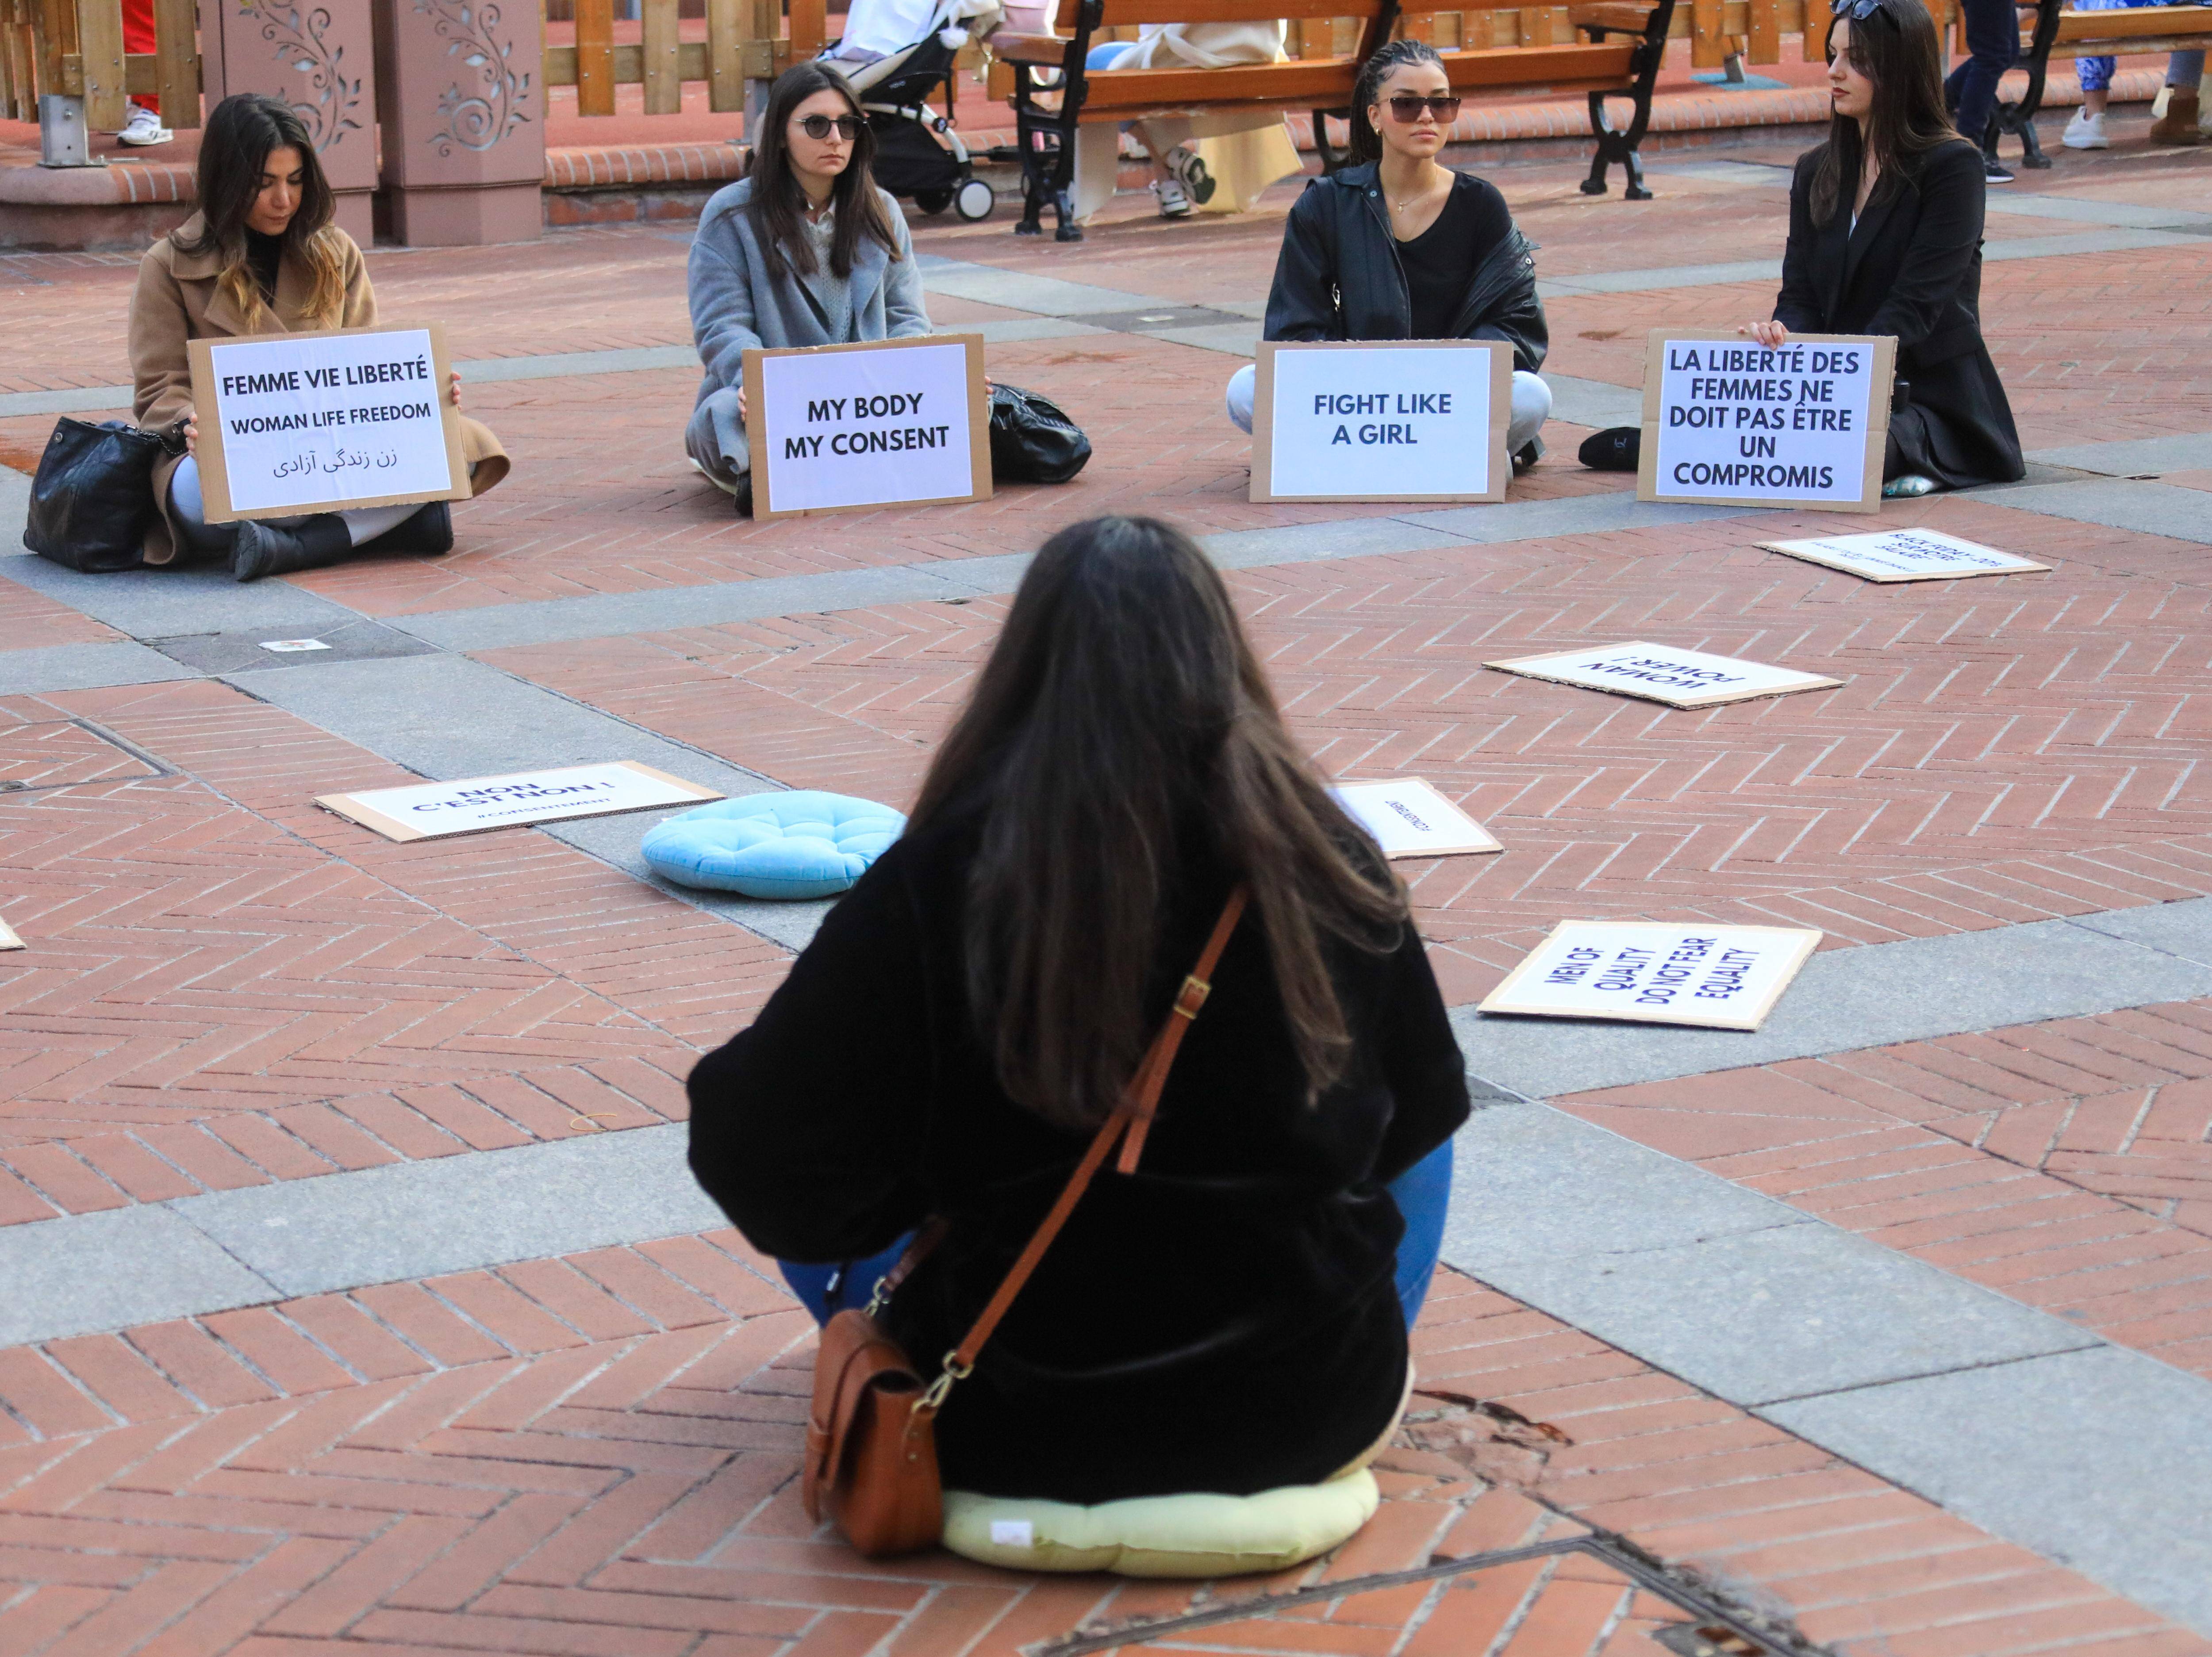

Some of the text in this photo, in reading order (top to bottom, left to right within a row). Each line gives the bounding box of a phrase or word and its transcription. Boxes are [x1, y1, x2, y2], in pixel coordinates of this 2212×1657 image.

[1671, 344, 1859, 374] LA LIBERTÉ DES
[223, 354, 427, 396] FEMME VIE LIBERTÉ
[1315, 394, 1451, 414] FIGHT LIKE
[1692, 378, 1833, 402] FEMMES NE
[231, 403, 430, 434] WOMAN LIFE FREEDOM
[808, 393, 923, 422] MY BODY
[1670, 402, 1851, 431] DOIT PAS ÊTRE
[786, 426, 949, 459] MY CONSENT
[1332, 424, 1417, 445] A GIRL
[1740, 436, 1775, 458] UN
[274, 449, 396, 478] زن زندگی آزادی
[1674, 463, 1832, 488] COMPROMIS
[1578, 664, 1707, 688] WOMAN
[1632, 660, 1745, 682] POWER
[413, 795, 503, 811] C'EST
[513, 785, 595, 798] NON
[457, 784, 540, 797] NON
[478, 799, 610, 818] #CONSENTEMENT
[1544, 948, 1605, 984] MEN OF
[1594, 947, 1656, 990] QUALITY
[1635, 939, 1717, 1004] DO NOT FEAR
[1694, 948, 1759, 999] EQUALITY
